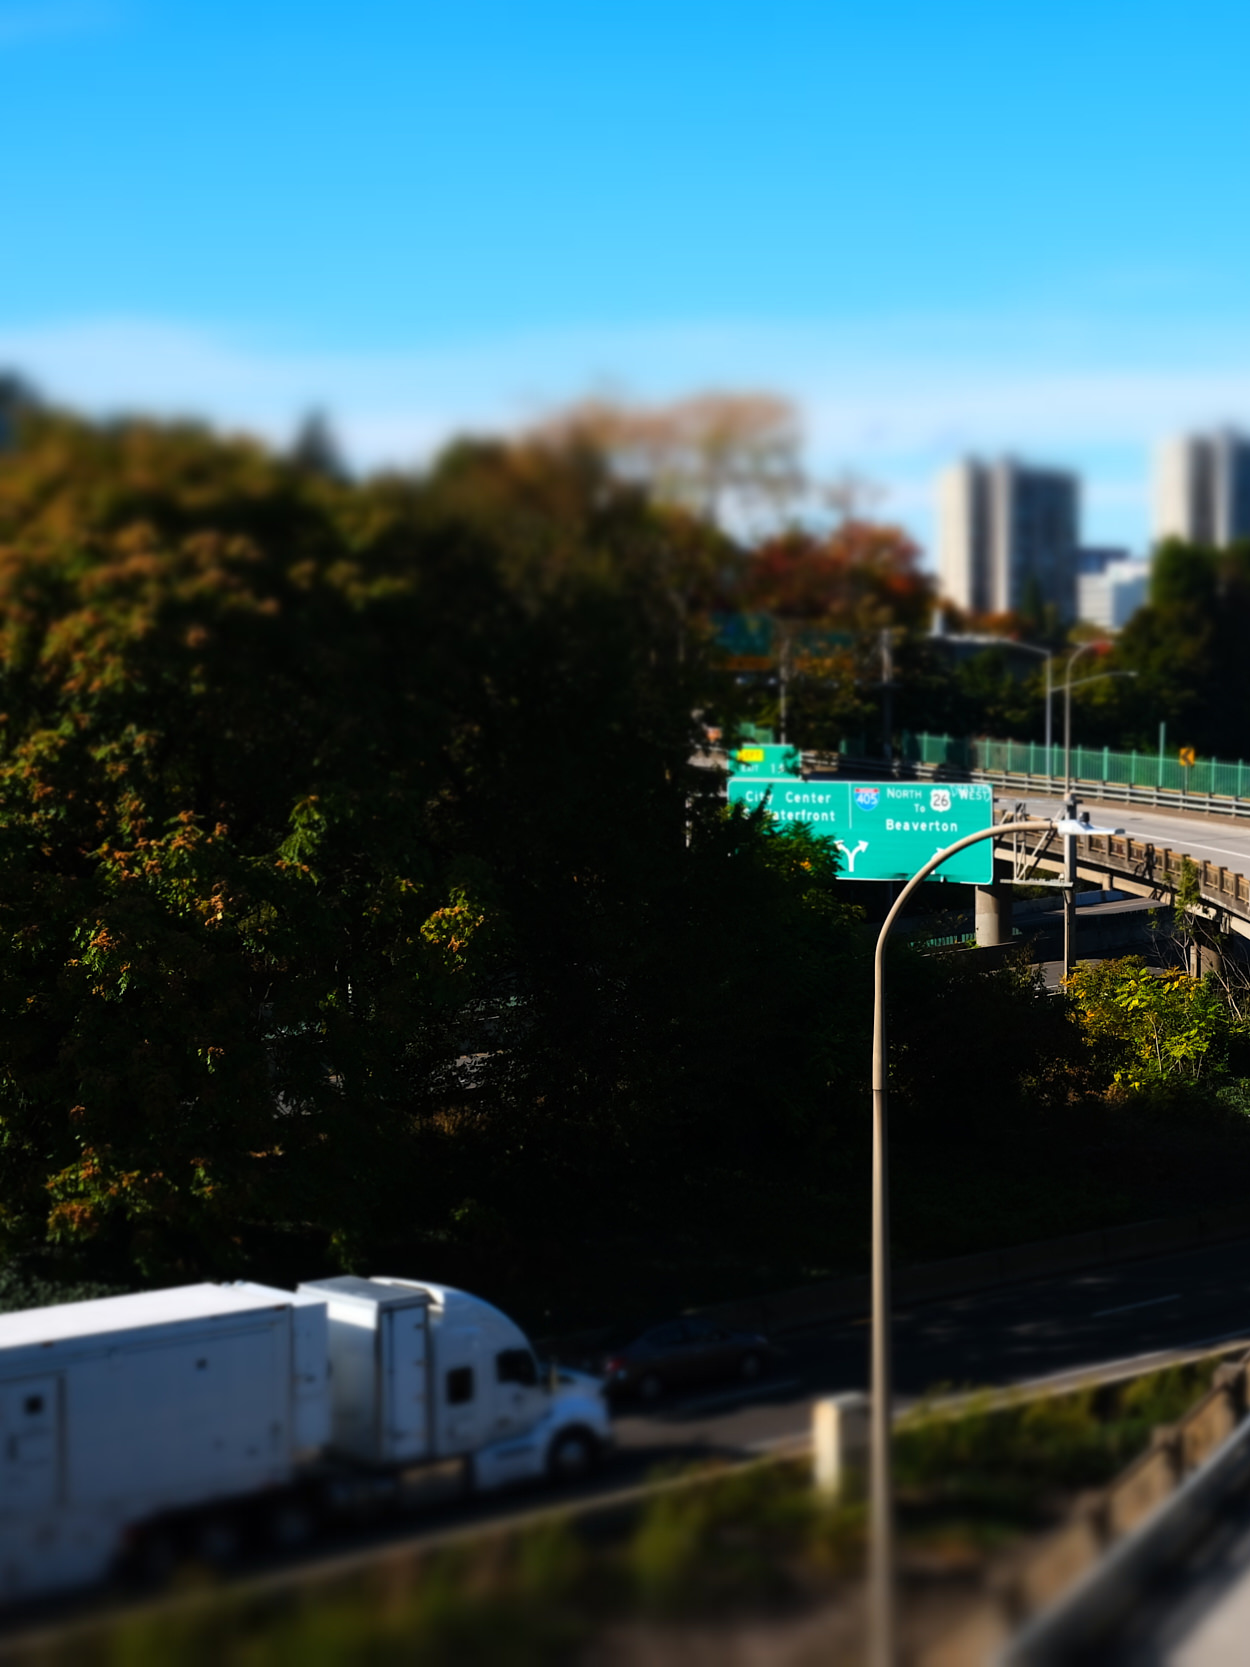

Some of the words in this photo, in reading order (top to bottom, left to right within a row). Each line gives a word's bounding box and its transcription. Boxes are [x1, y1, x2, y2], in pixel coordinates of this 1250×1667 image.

[745, 790, 774, 806] City
[785, 791, 832, 804] Center
[856, 792, 877, 806] 405
[886, 787, 923, 799] NORTH
[932, 793, 949, 807] 26
[885, 818, 958, 832] Beaverton
